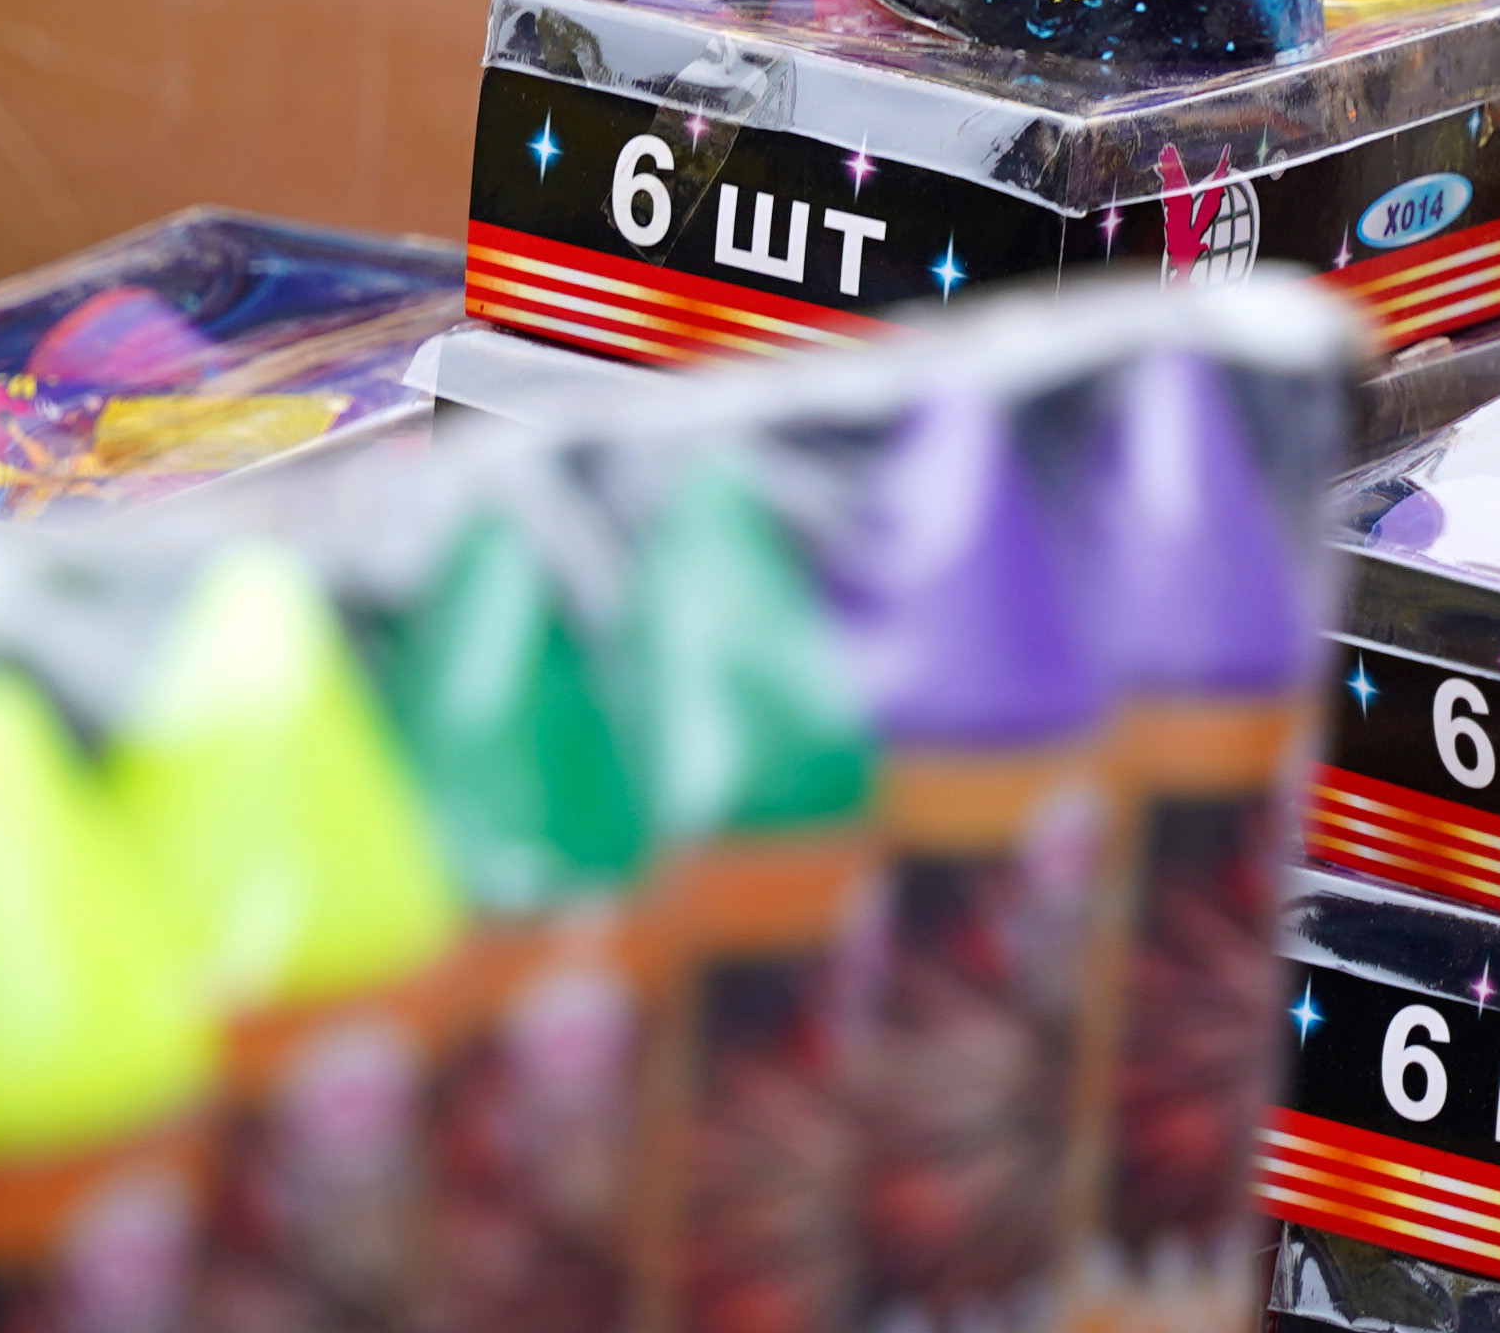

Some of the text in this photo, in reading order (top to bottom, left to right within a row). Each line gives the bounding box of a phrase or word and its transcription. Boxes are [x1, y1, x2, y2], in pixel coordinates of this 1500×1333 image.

[612, 133, 675, 247] 6
[1432, 677, 1496, 790] 6
[1380, 1003, 1451, 1123] 6
